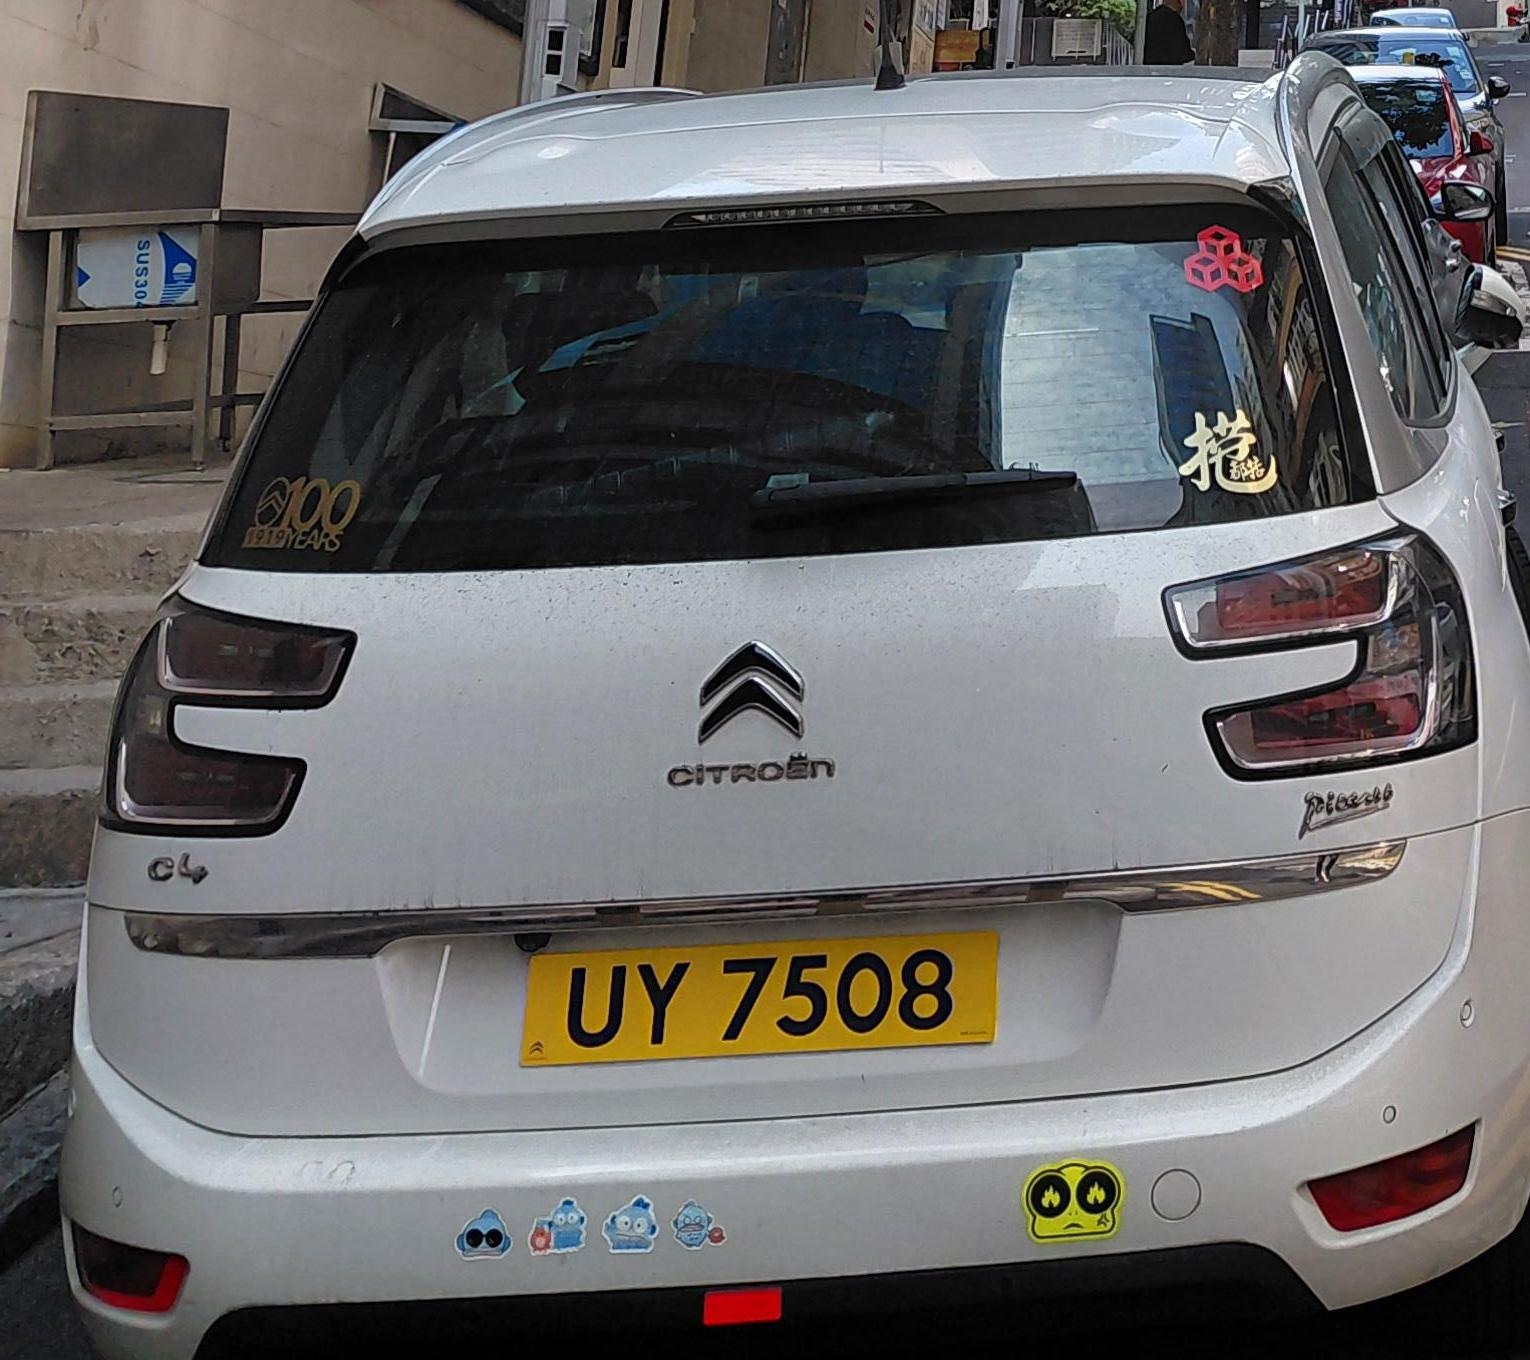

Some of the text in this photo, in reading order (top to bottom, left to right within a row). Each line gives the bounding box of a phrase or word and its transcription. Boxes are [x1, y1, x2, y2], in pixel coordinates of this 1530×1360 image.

[280, 476, 361, 532] 100
[286, 529, 344, 552] YEARS
[147, 852, 209, 886] C4
[566, 948, 954, 1048] UY 7508
